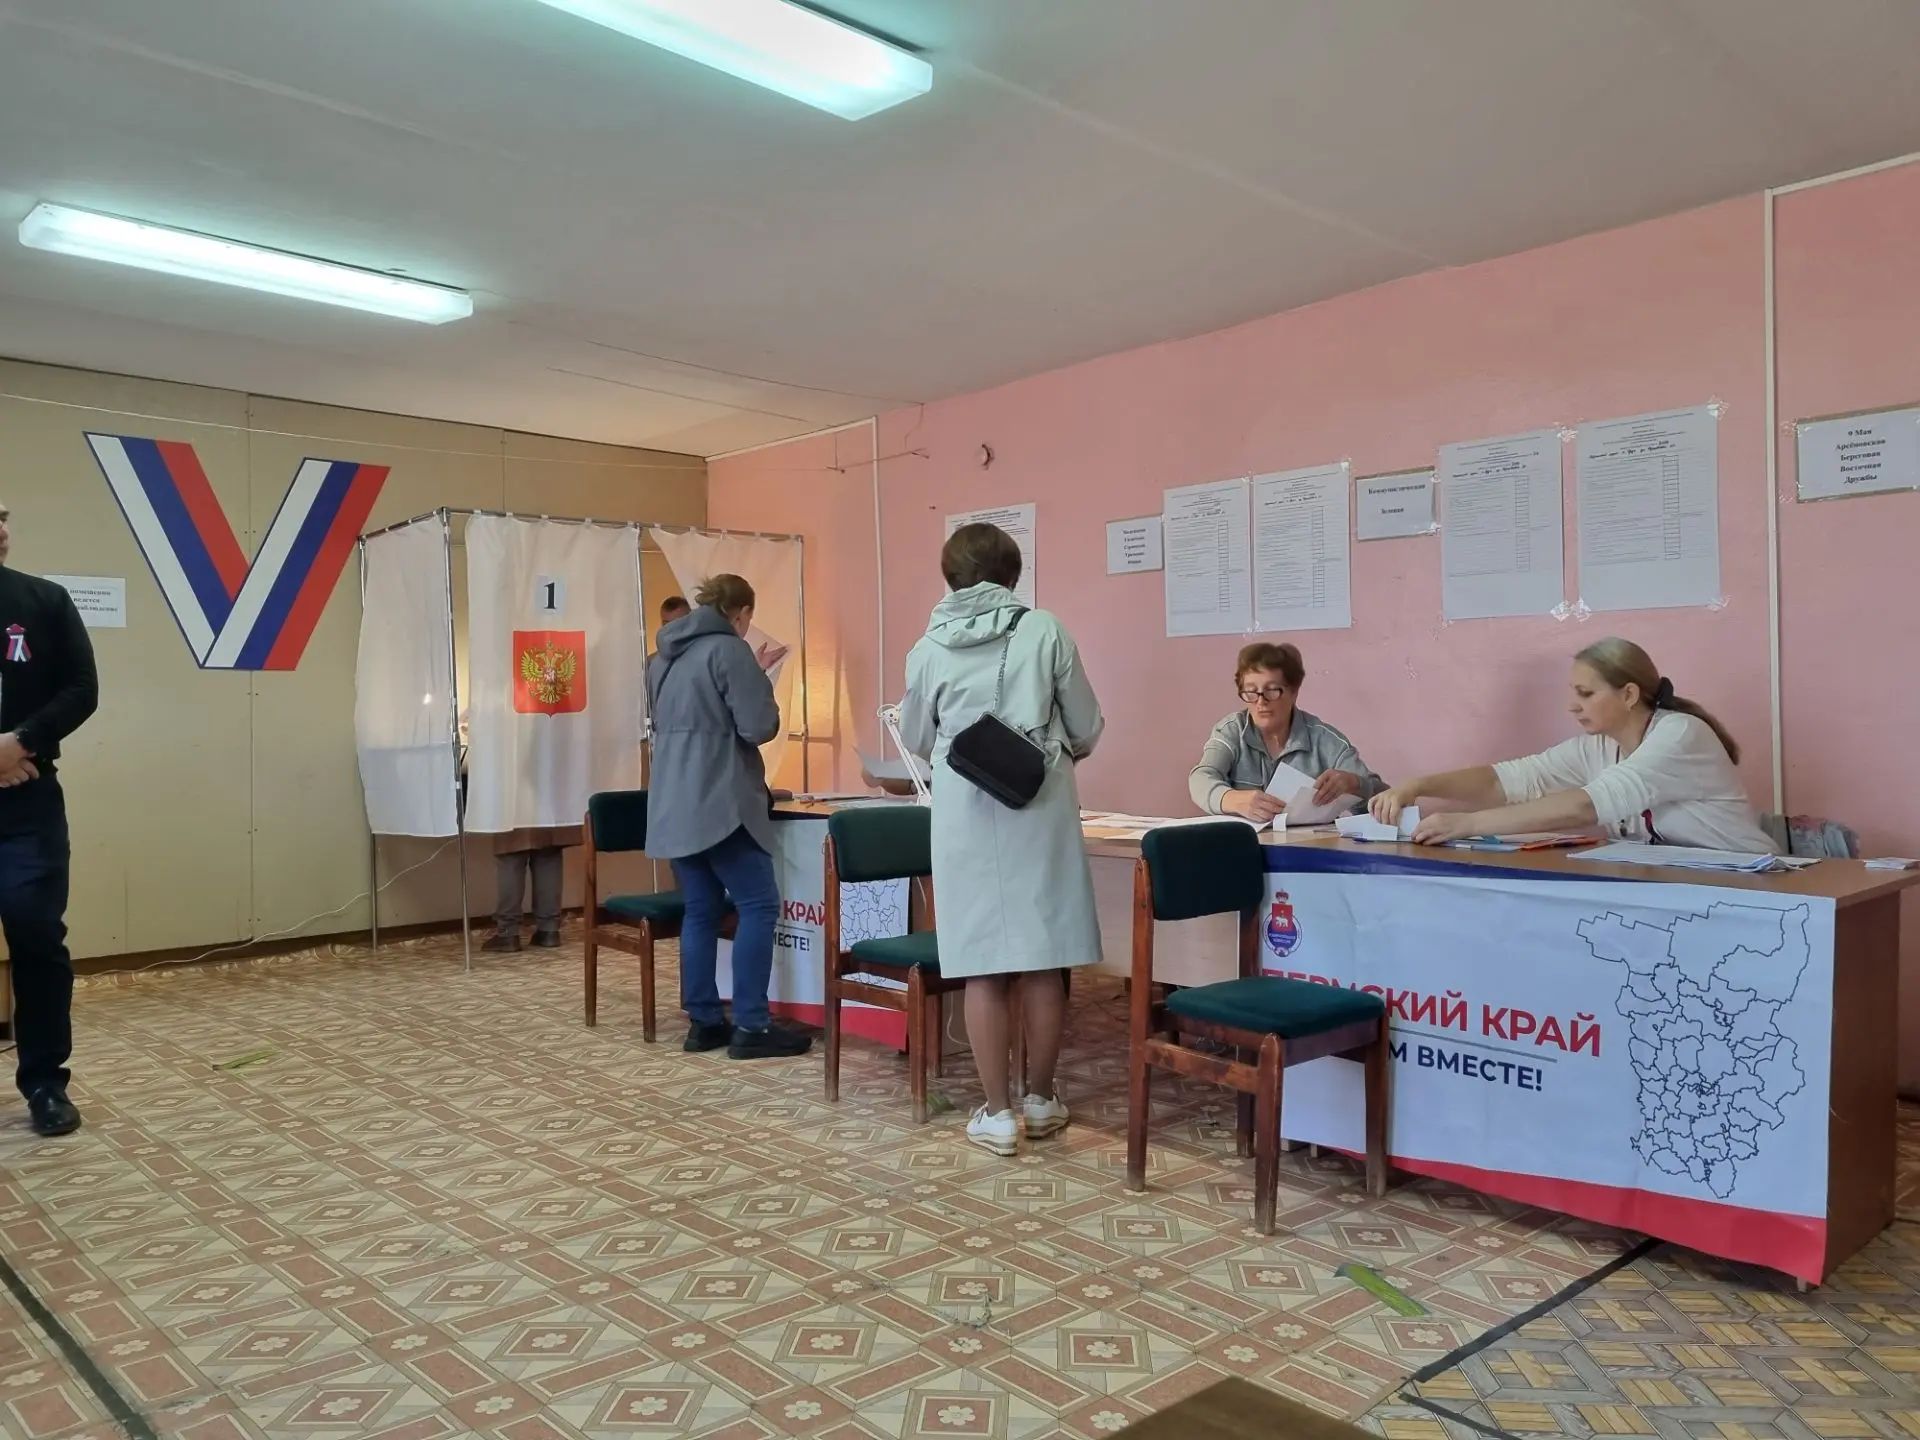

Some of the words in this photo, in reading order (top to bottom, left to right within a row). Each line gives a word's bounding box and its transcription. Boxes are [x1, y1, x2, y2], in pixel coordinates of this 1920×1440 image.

[1841, 452, 1880, 461] Береговая
[1840, 463, 1882, 472] Восточная
[1844, 474, 1878, 484] Дружбы
[543, 582, 556, 610] 1
[1482, 1003, 1601, 1058] КРАЙ
[1417, 1045, 1544, 1092] ВМЕСТЕ!
